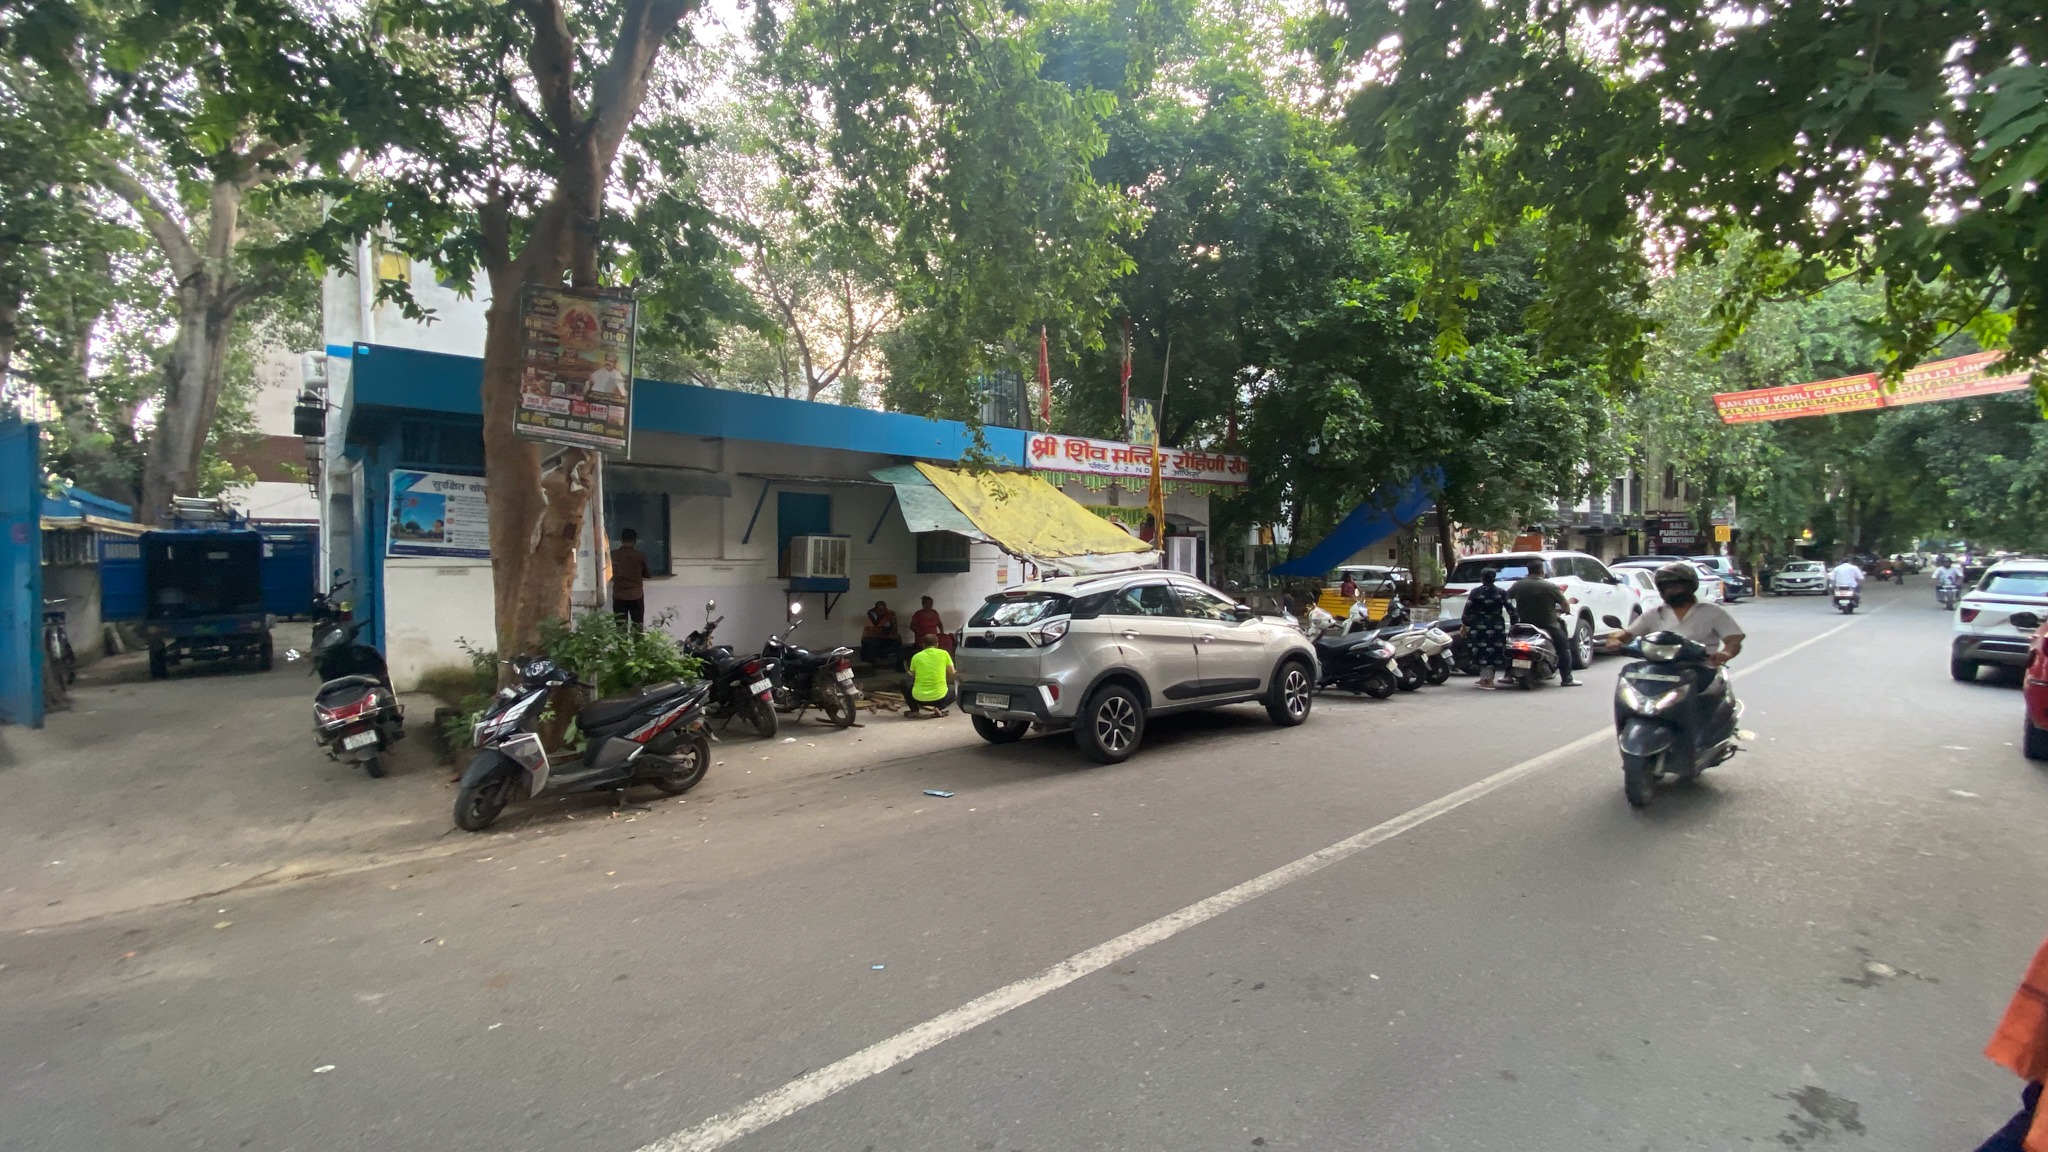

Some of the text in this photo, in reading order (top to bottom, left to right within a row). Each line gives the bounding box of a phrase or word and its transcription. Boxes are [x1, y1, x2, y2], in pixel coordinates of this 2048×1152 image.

[1719, 382, 1873, 409] SANJEEV KOHLI CLASSES
[1724, 406, 1761, 416] XI-XII
[1765, 391, 1876, 412] MATHEMATICS
[1031, 436, 1058, 460] श्री
[1064, 439, 1108, 463] शिव
[1173, 451, 1226, 473] रोहिणी
[432, 479, 466, 491] सुरक्षित
